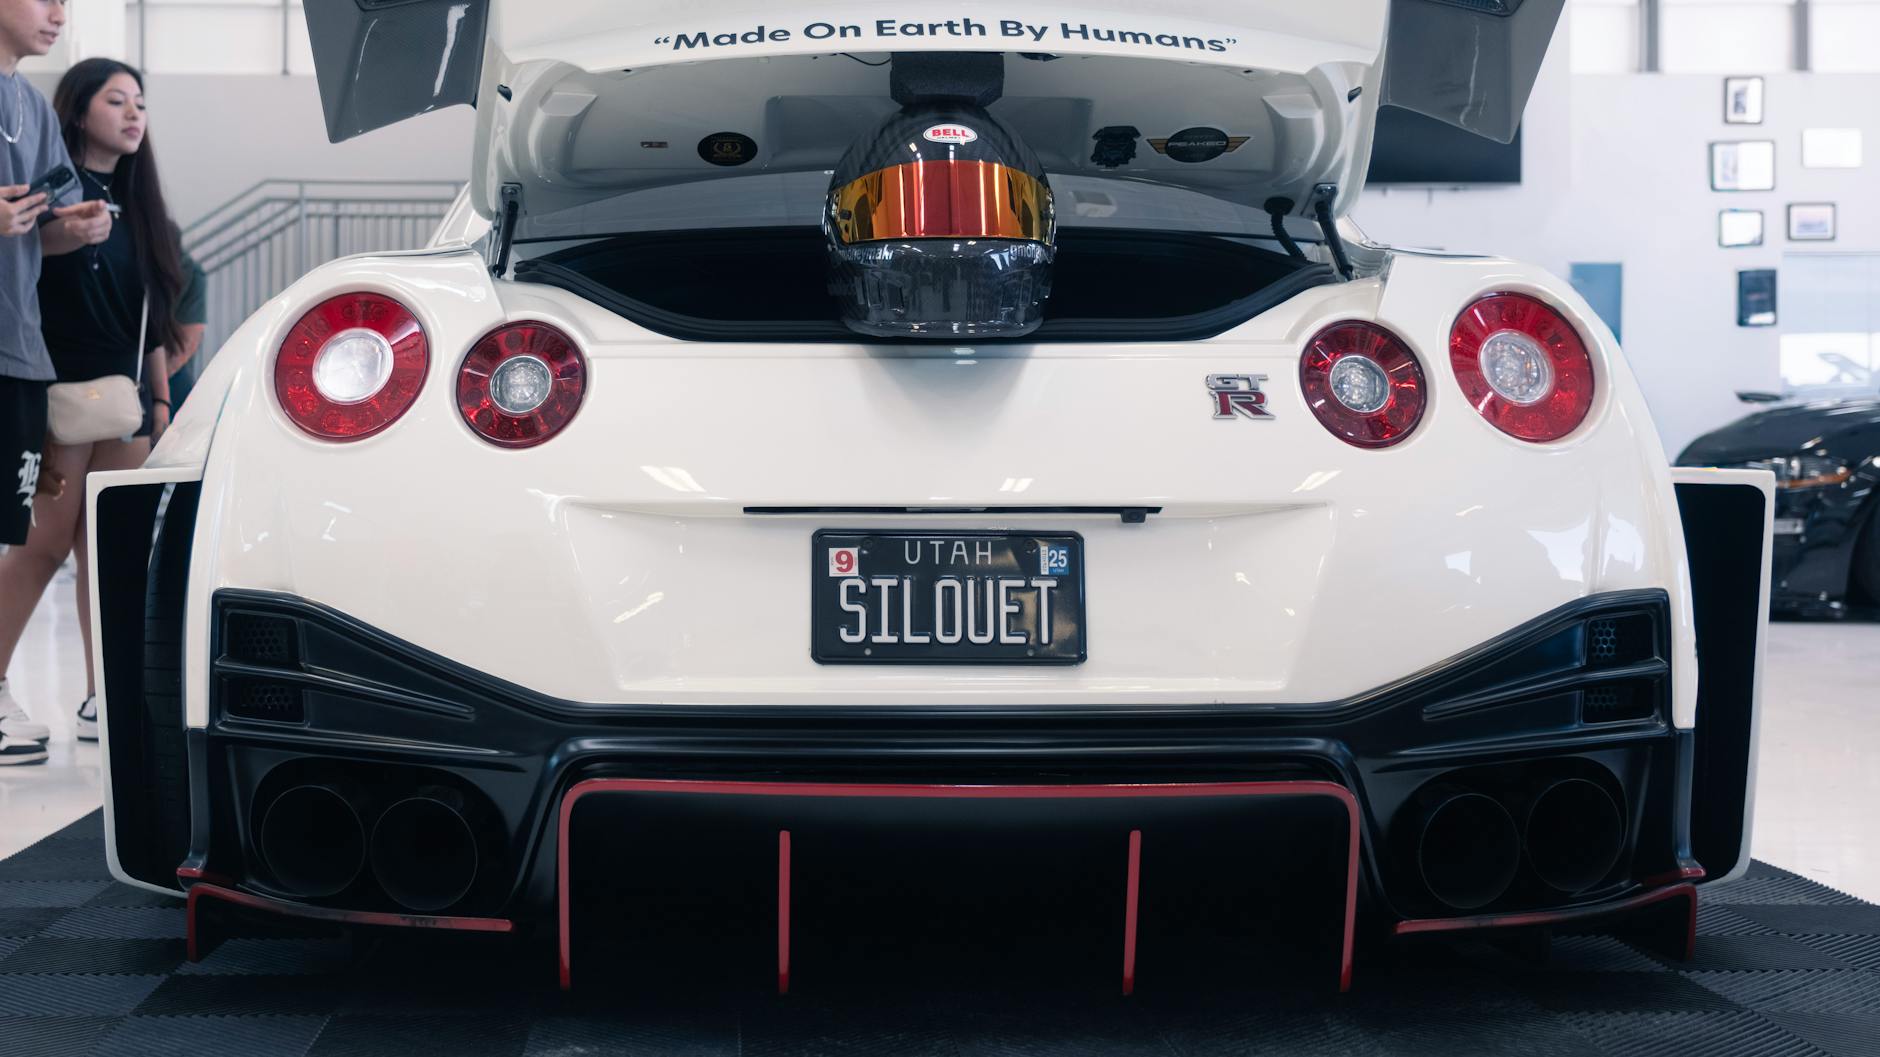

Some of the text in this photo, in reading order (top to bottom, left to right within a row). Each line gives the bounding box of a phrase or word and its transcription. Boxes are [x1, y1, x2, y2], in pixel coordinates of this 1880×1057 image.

[803, 22, 861, 39] On
[875, 18, 986, 36] Earth
[1000, 20, 1048, 41] By
[932, 128, 970, 138] BELL
[1205, 373, 1269, 390] GT
[1208, 390, 1276, 420] R
[835, 550, 854, 573] 9
[904, 541, 992, 565] UTAH
[1048, 549, 1068, 568] 25
[839, 578, 1058, 645] SILOUET
